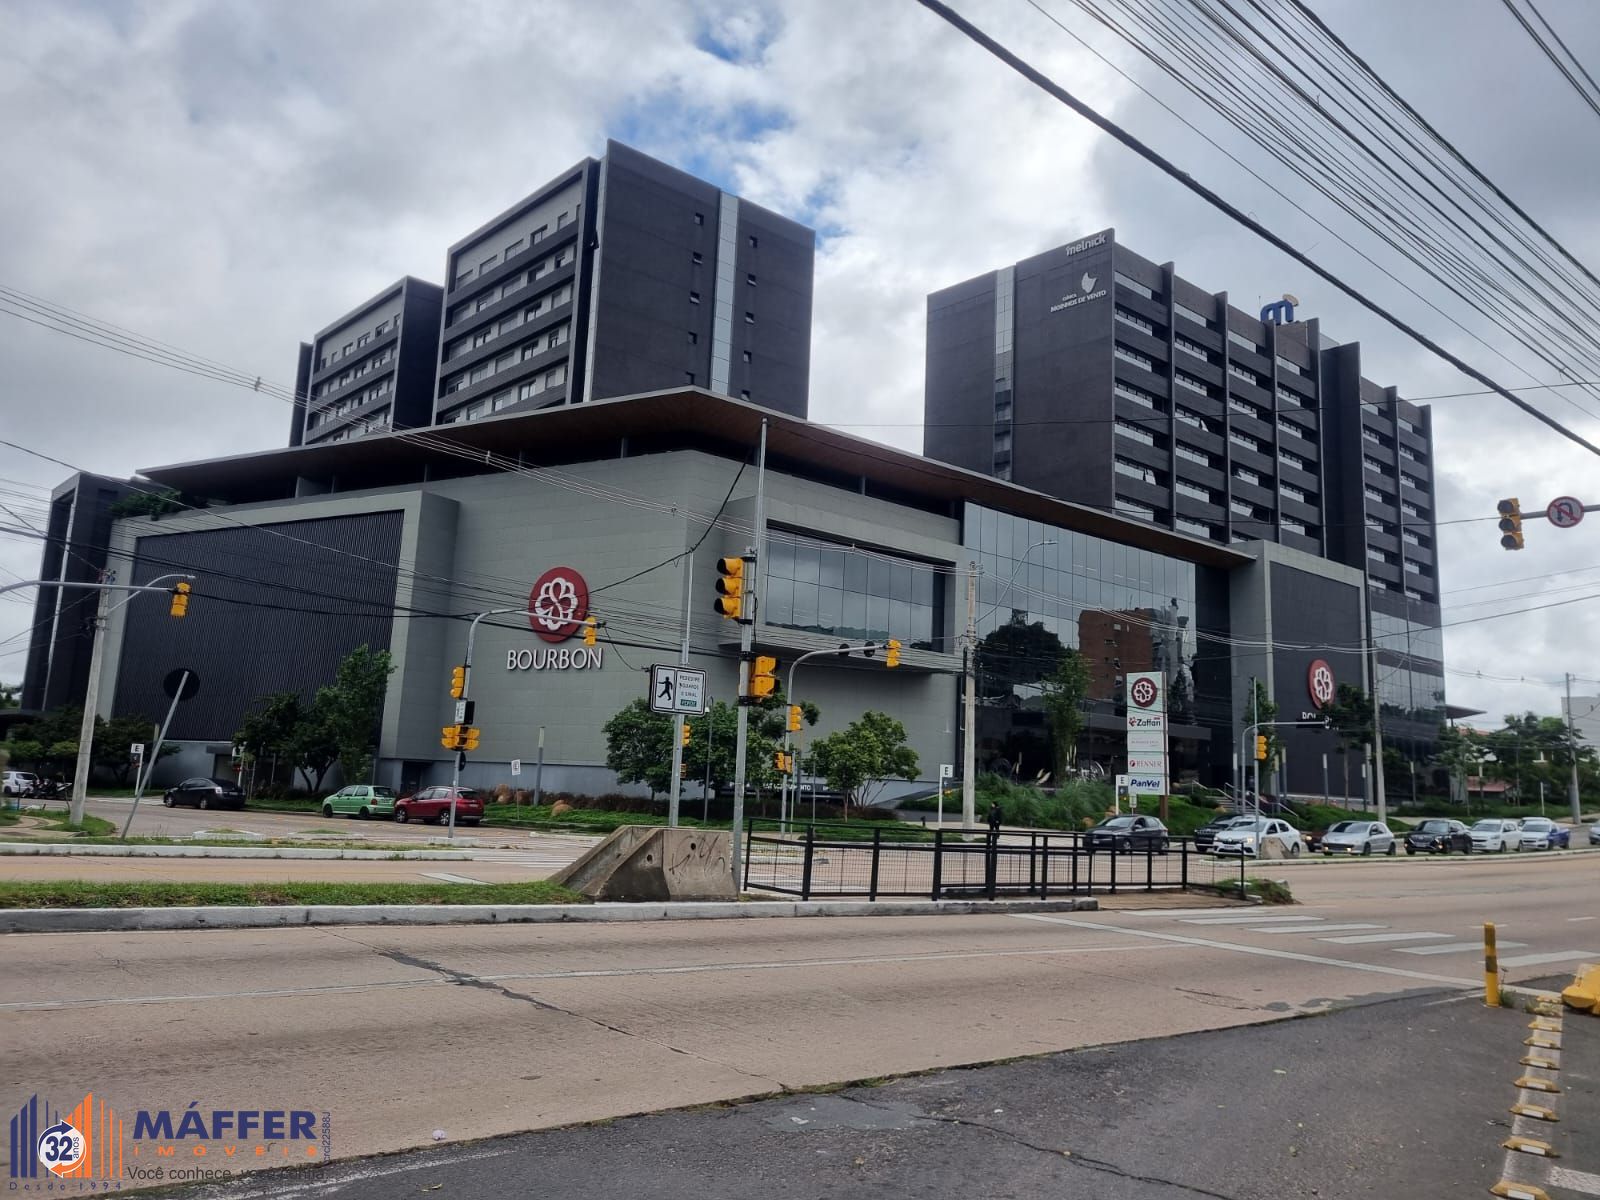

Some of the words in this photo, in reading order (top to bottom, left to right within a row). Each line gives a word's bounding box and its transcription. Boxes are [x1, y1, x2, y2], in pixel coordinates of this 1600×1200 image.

[1066, 235, 1106, 256] melnick
[1087, 290, 1106, 300] VENTO
[506, 647, 604, 670] BOURBON
[1130, 780, 1160, 788] PanVel
